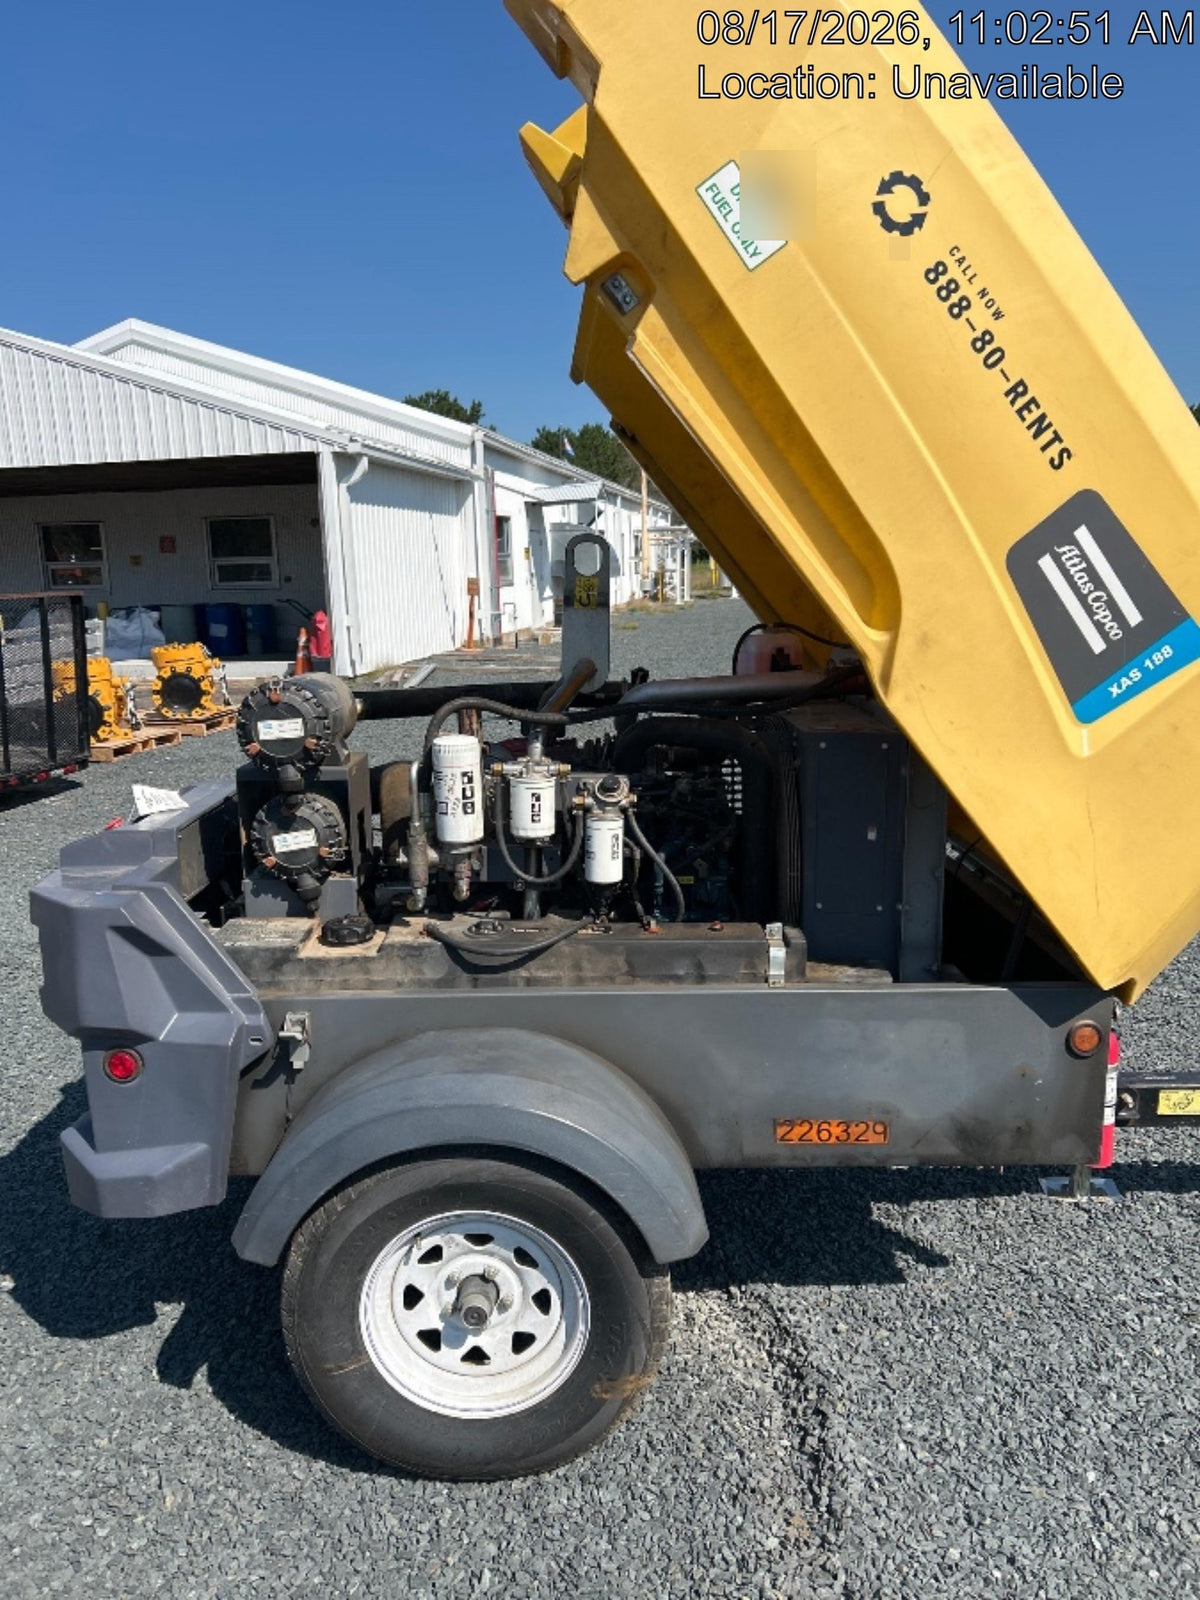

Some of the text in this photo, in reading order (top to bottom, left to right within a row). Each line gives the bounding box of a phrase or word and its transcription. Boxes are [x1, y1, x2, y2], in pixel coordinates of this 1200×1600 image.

[705, 183, 733, 222] FUEL
[949, 245, 1006, 321] CALL NOW
[924, 260, 1073, 471] 888-80-RENTS
[1107, 645, 1174, 699] XAS 188
[779, 1119, 888, 1142] 226329
